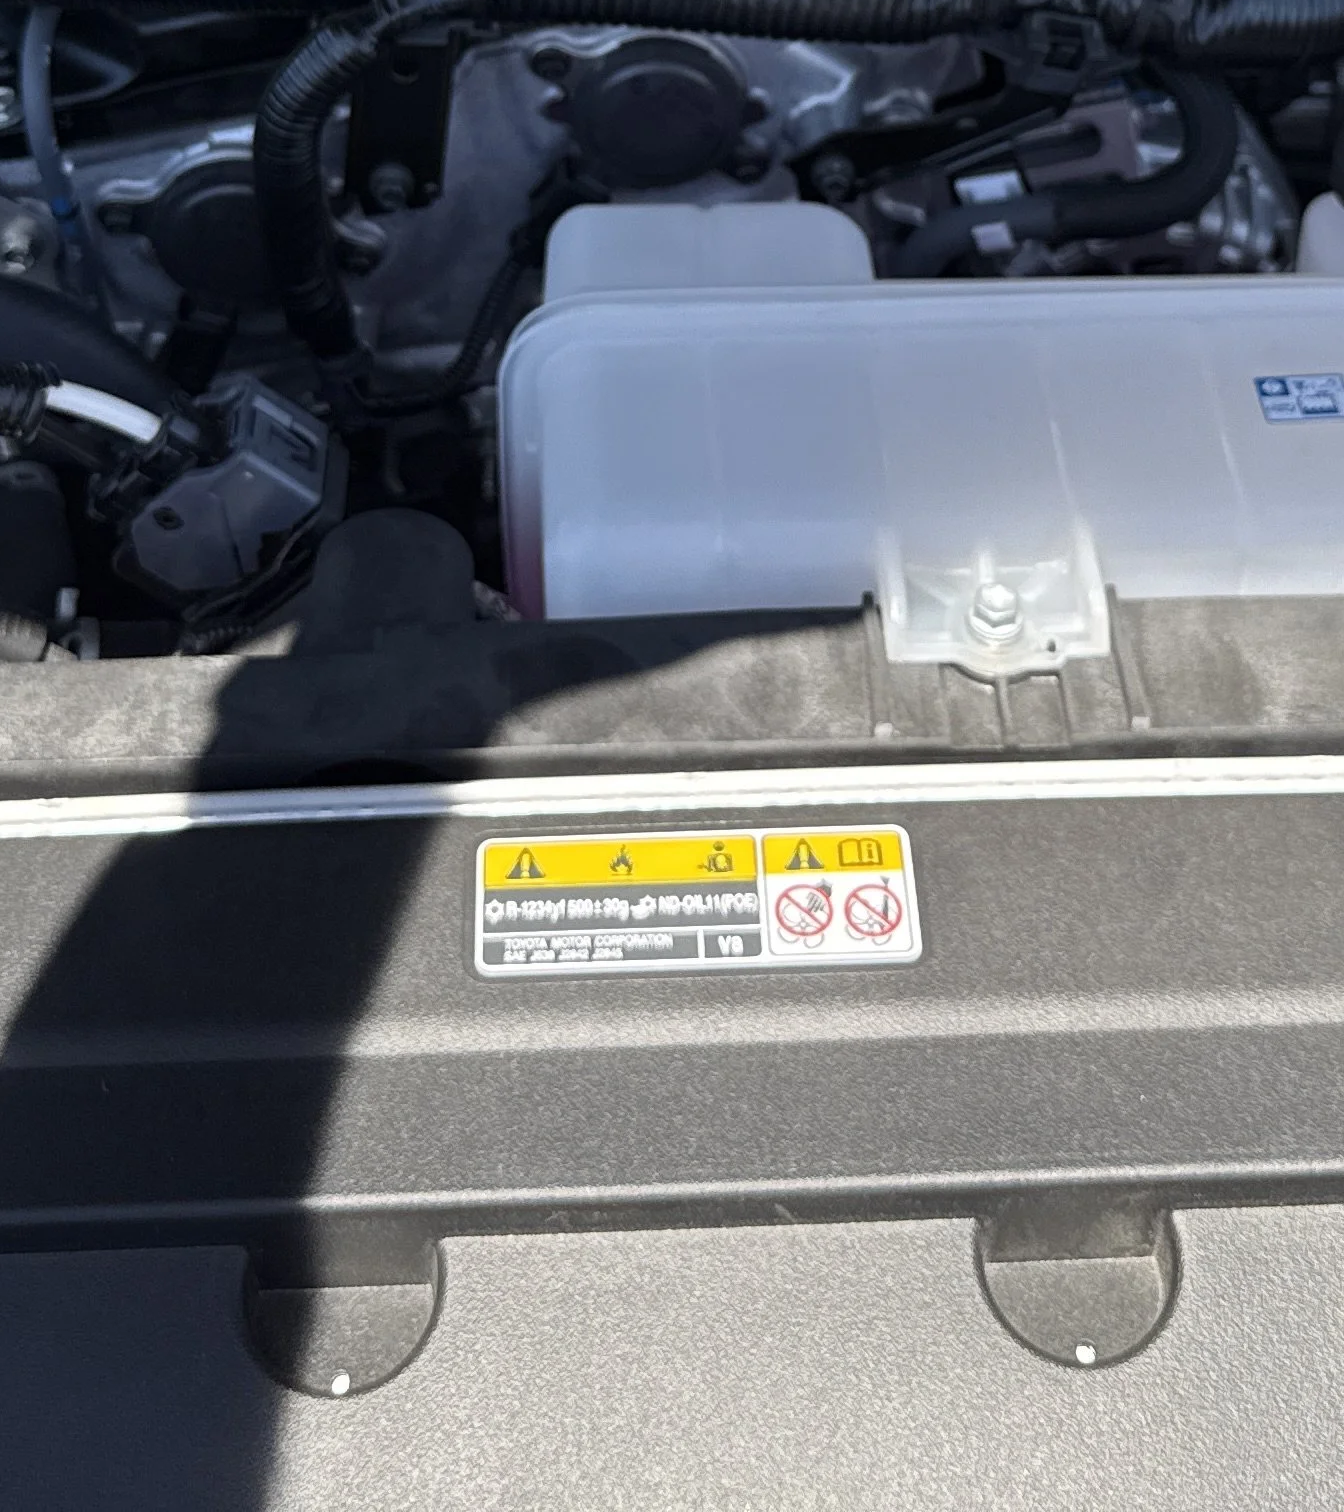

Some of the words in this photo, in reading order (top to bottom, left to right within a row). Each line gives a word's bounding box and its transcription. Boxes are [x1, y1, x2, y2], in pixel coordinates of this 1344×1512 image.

[504, 938, 548, 951] TOYOTA
[550, 936, 592, 949] MOTOR
[593, 933, 674, 950] CORPORATION
